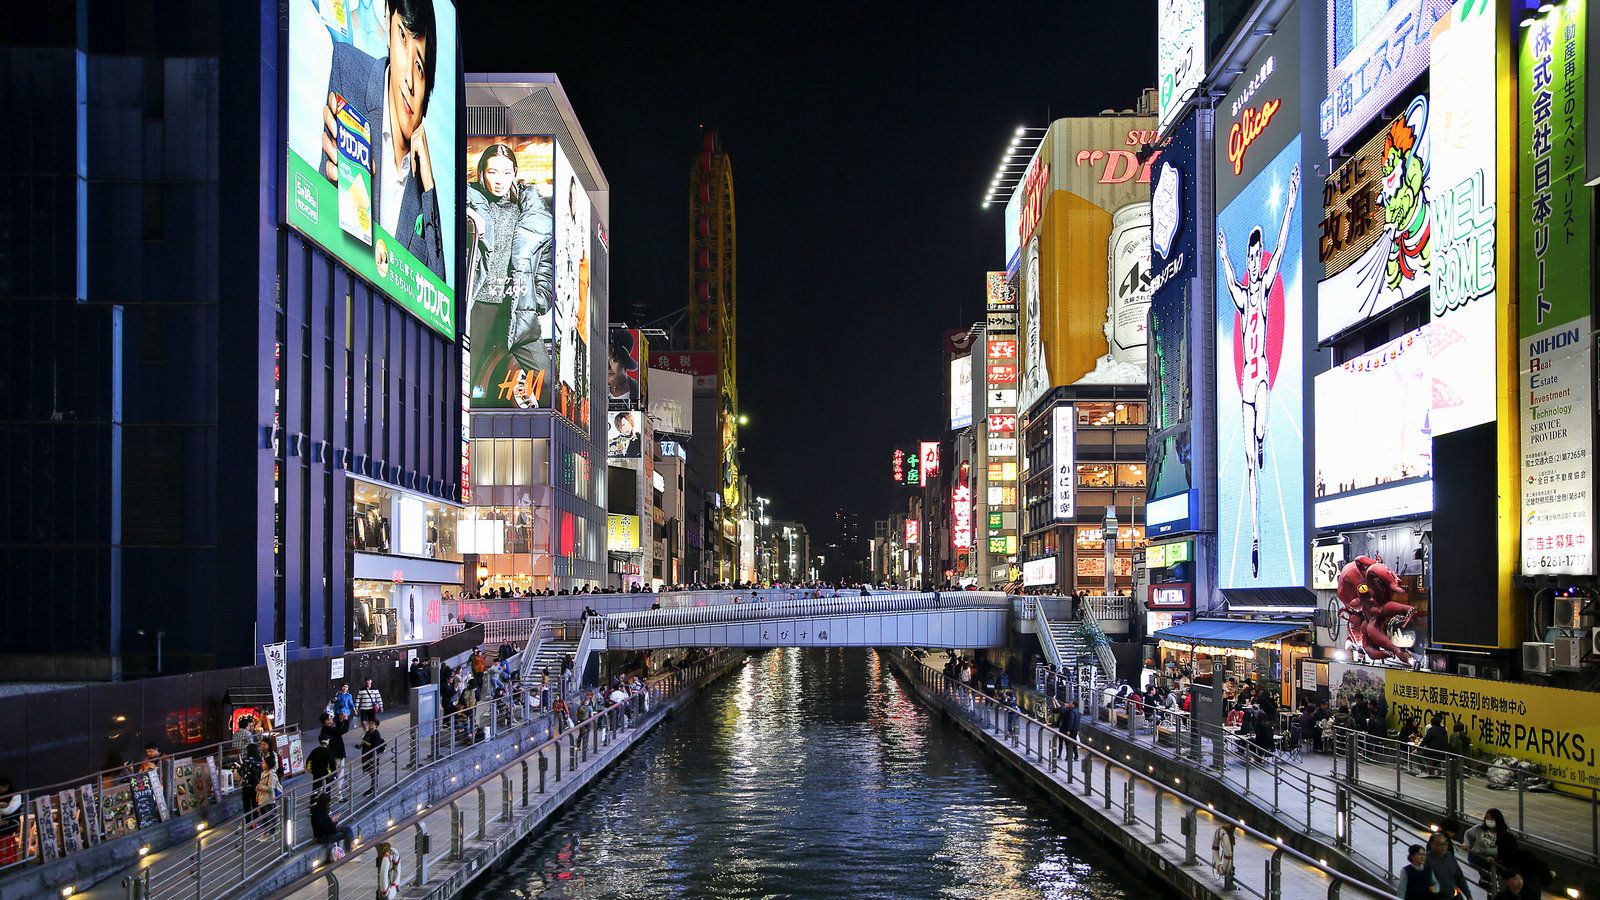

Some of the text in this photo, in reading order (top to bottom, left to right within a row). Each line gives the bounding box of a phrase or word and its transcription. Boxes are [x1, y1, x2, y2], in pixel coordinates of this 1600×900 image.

[339, 125, 371, 170] サロンパス
[1227, 98, 1281, 176] Glico
[1531, 22, 1553, 325] 株式会社日本リート
[1318, 182, 1372, 263] 改源
[415, 272, 452, 328] サロンパス
[1529, 328, 1579, 358] NIHON
[1530, 358, 1552, 374] Real
[1530, 374, 1558, 390] Estate
[1530, 388, 1571, 406] Investment
[1529, 404, 1573, 421] Technology
[1530, 419, 1561, 434] SERVICE
[1530, 429, 1568, 444] PROVIDER
[906, 454, 920, 481] 千房
[762, 630, 829, 641] えびす橋
[1392, 683, 1528, 716] 从这里到大阪最大级别的购物中心
